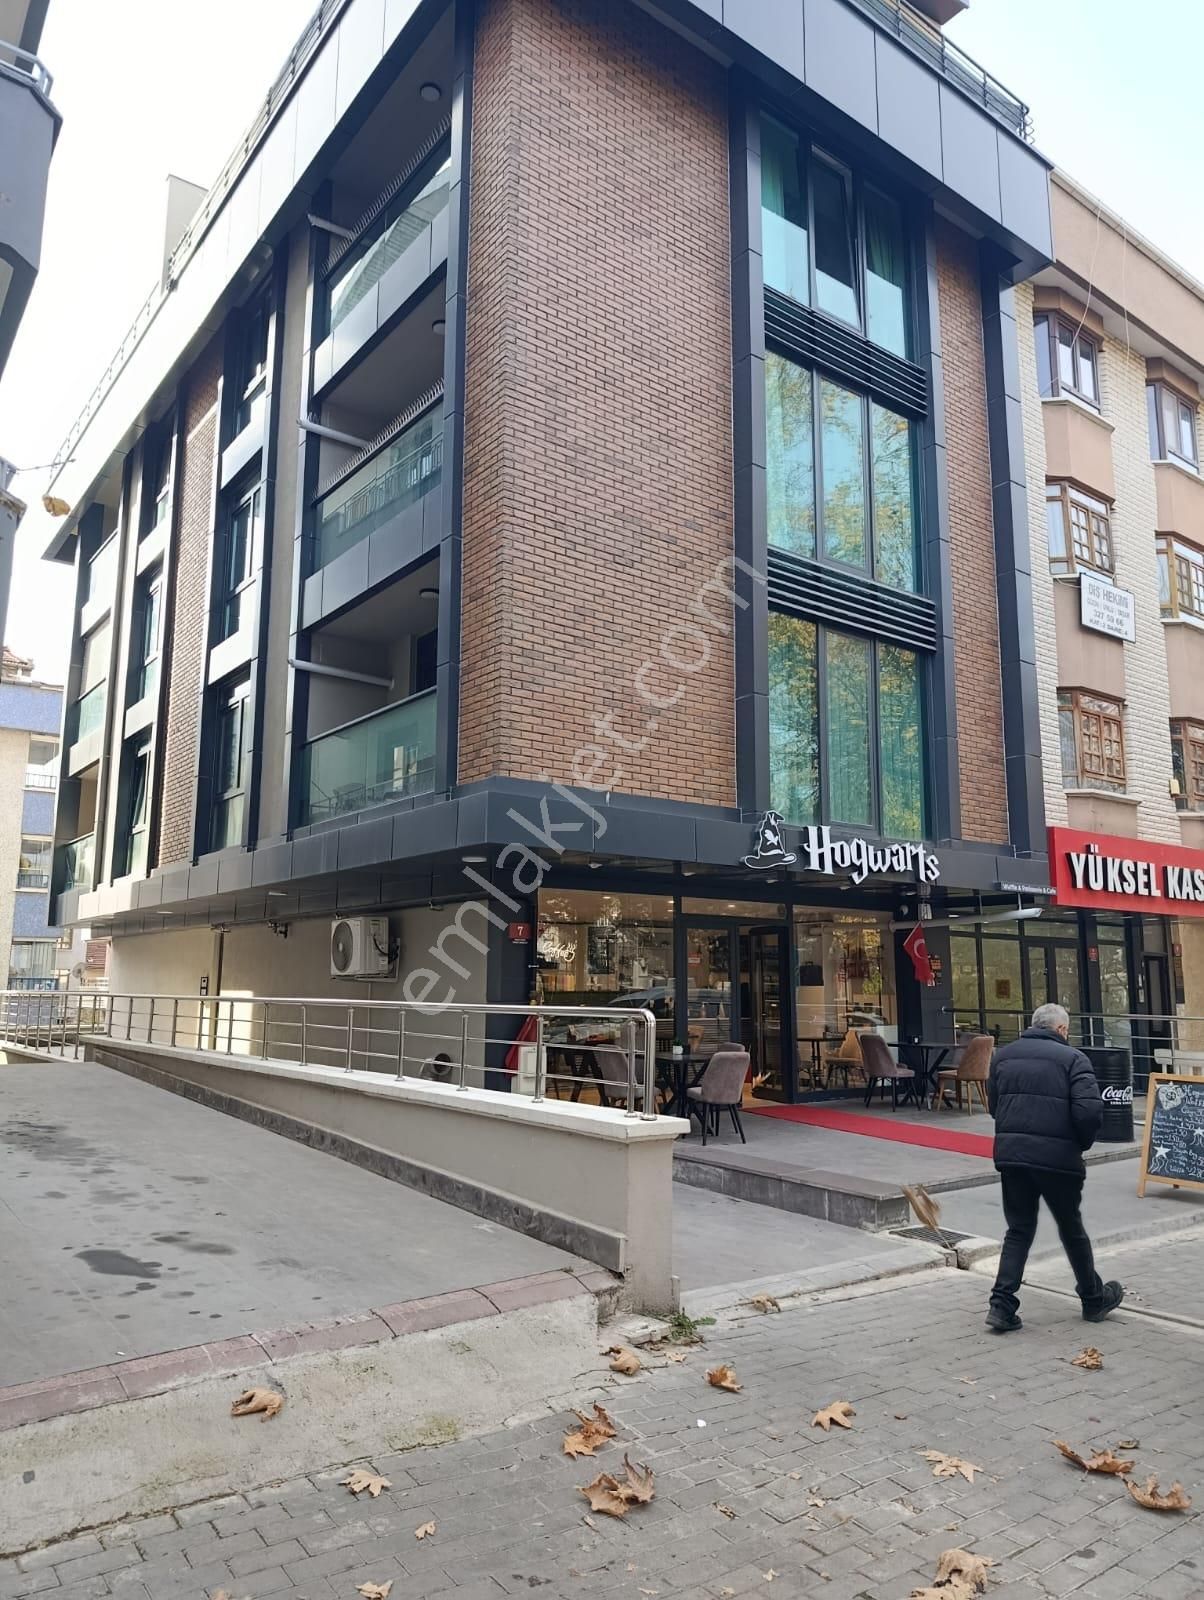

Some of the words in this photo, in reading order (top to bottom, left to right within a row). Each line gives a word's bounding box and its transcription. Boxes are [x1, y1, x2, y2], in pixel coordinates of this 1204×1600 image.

[802, 824, 941, 885] Hogwarts
[1066, 842, 1162, 897] YÜKSEL
[517, 926, 524, 936] 7
[1102, 1085, 1133, 1101] Coca-Co
